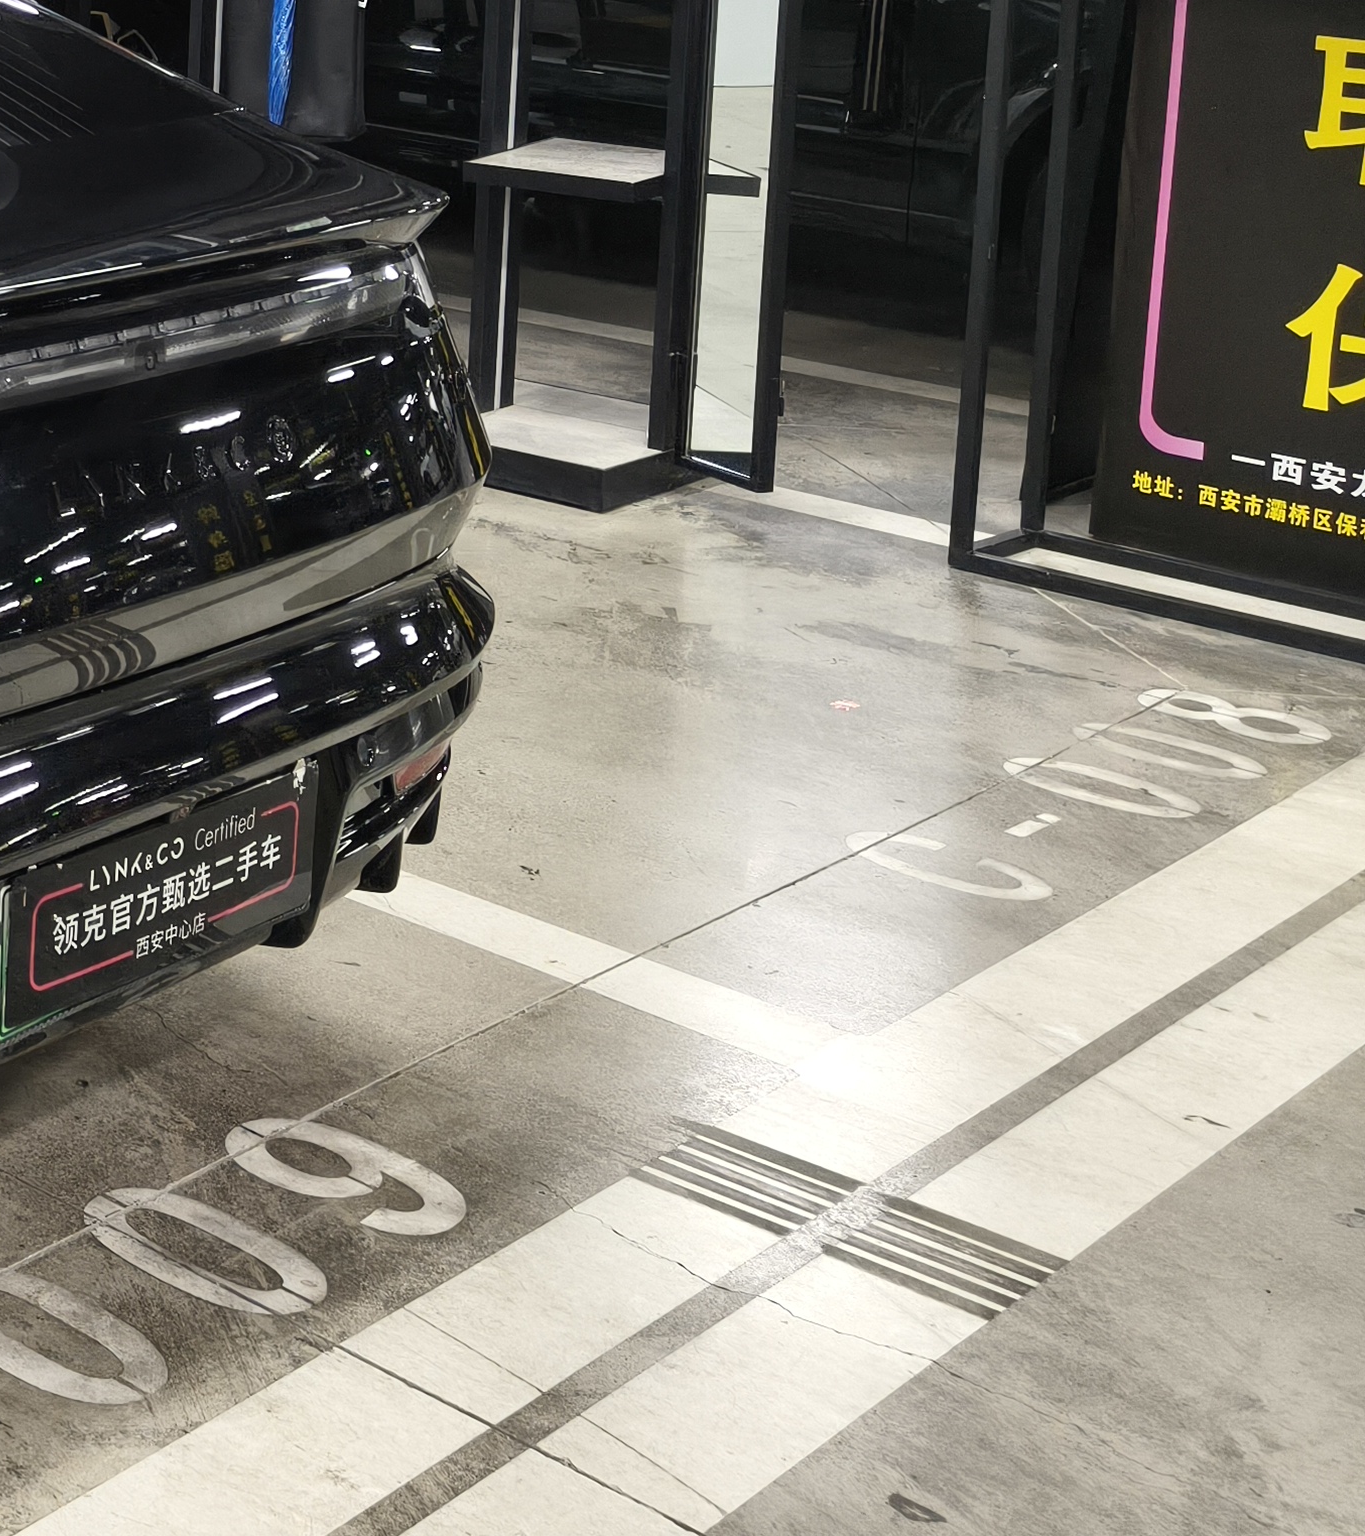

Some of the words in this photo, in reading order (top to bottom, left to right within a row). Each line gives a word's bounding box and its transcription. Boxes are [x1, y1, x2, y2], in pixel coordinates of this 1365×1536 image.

[845, 688, 1332, 901] C-008
[52, 832, 282, 956] 领克官方甄选二手车
[88, 841, 185, 893] LYNK&CO
[194, 807, 257, 852] Certified
[134, 911, 207, 960] 西安中心店
